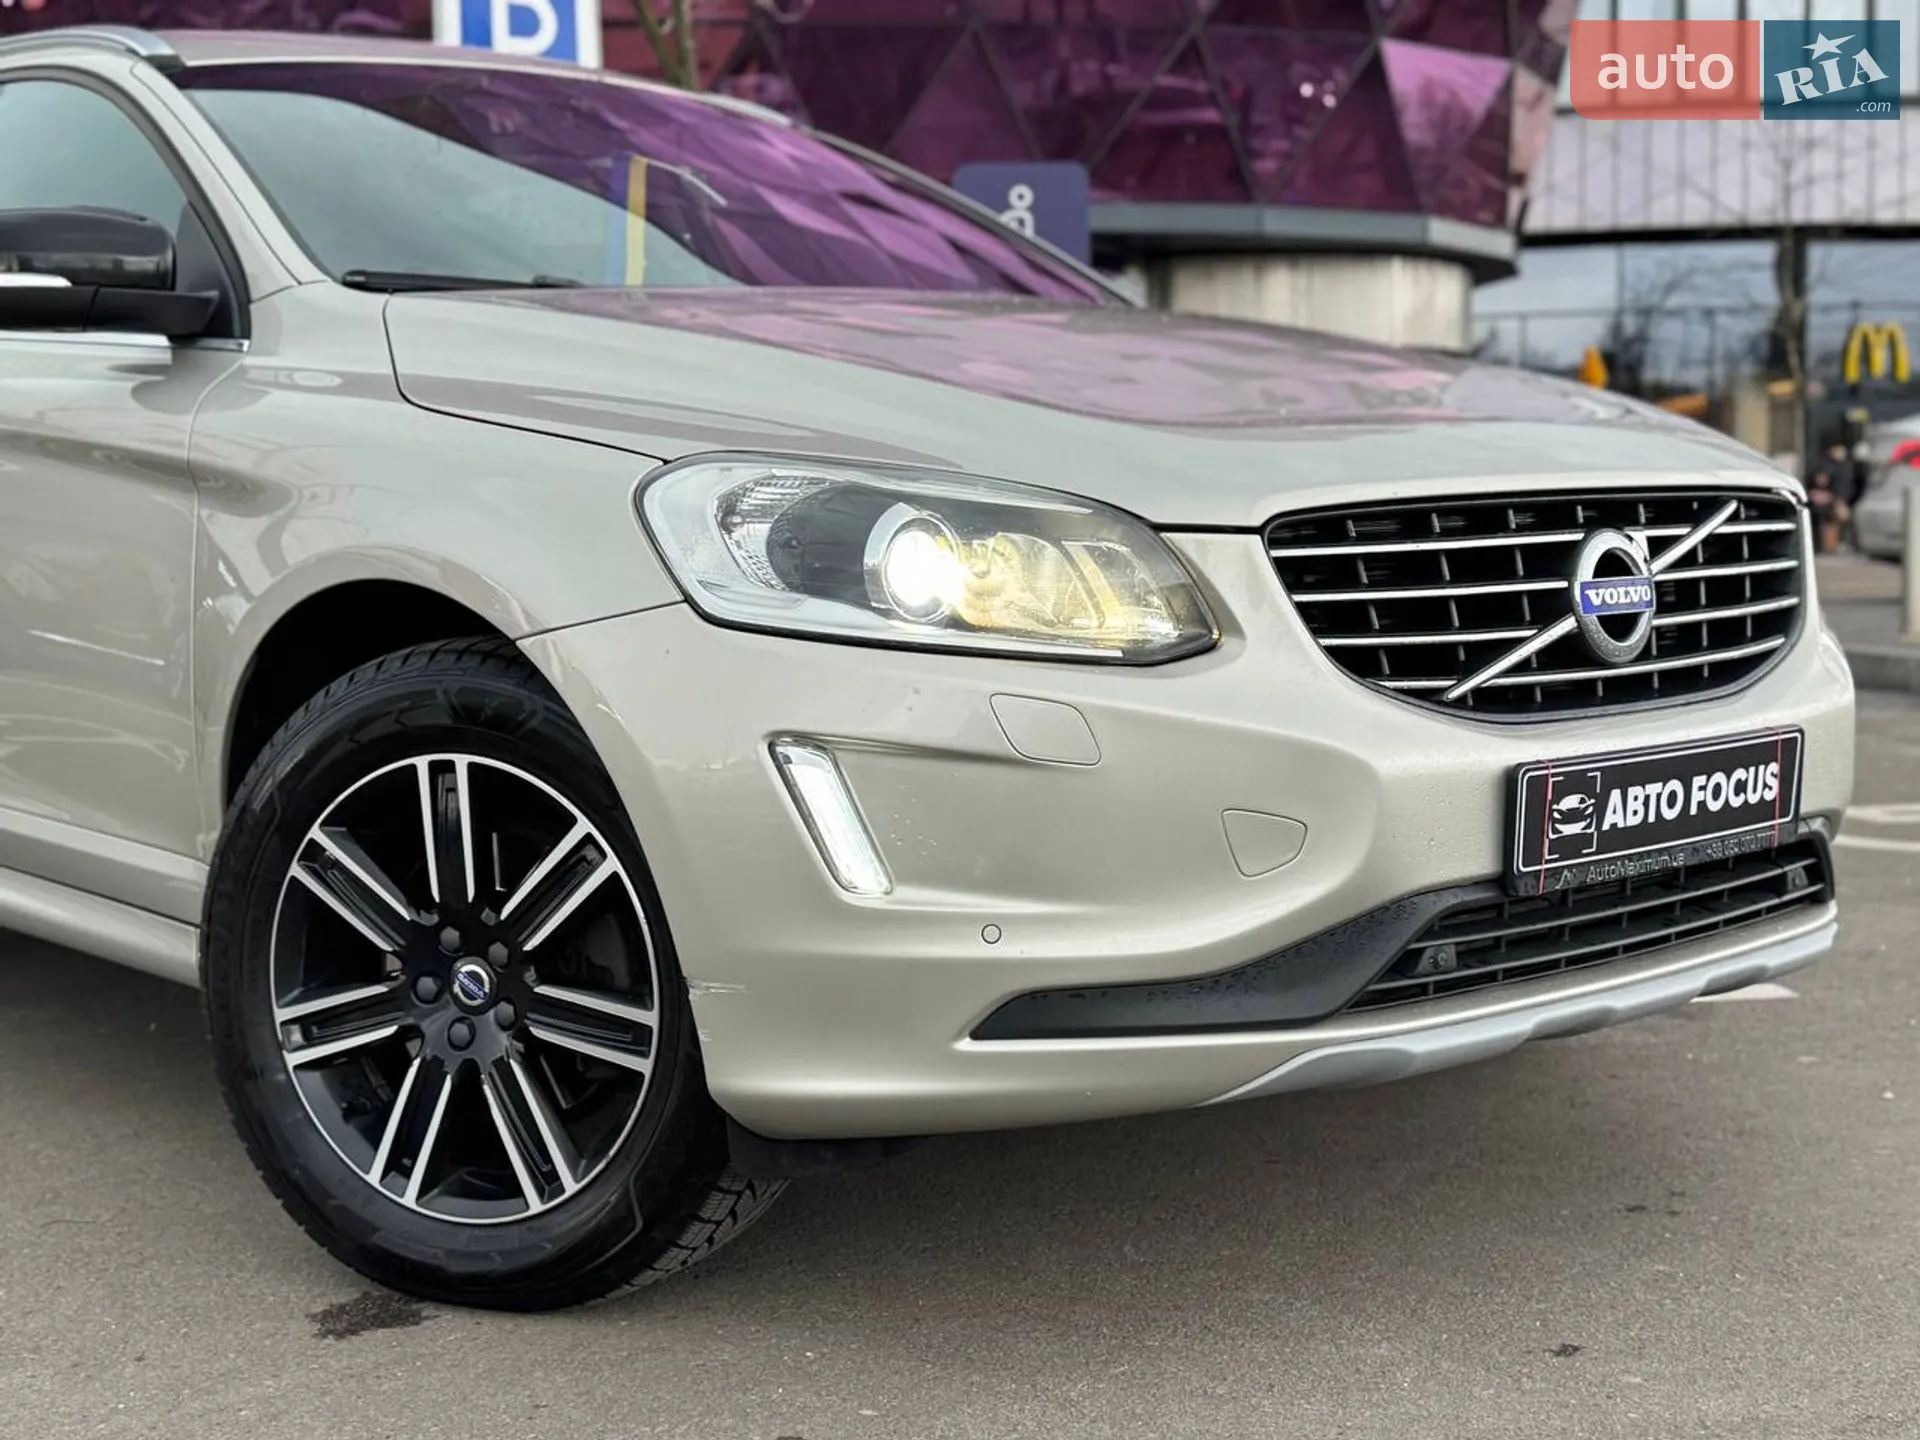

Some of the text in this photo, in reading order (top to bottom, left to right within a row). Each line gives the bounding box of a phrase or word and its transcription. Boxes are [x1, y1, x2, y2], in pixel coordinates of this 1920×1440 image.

[1585, 585, 1651, 606] VOLVO
[1602, 761, 1779, 831] АВТО FOCUS
